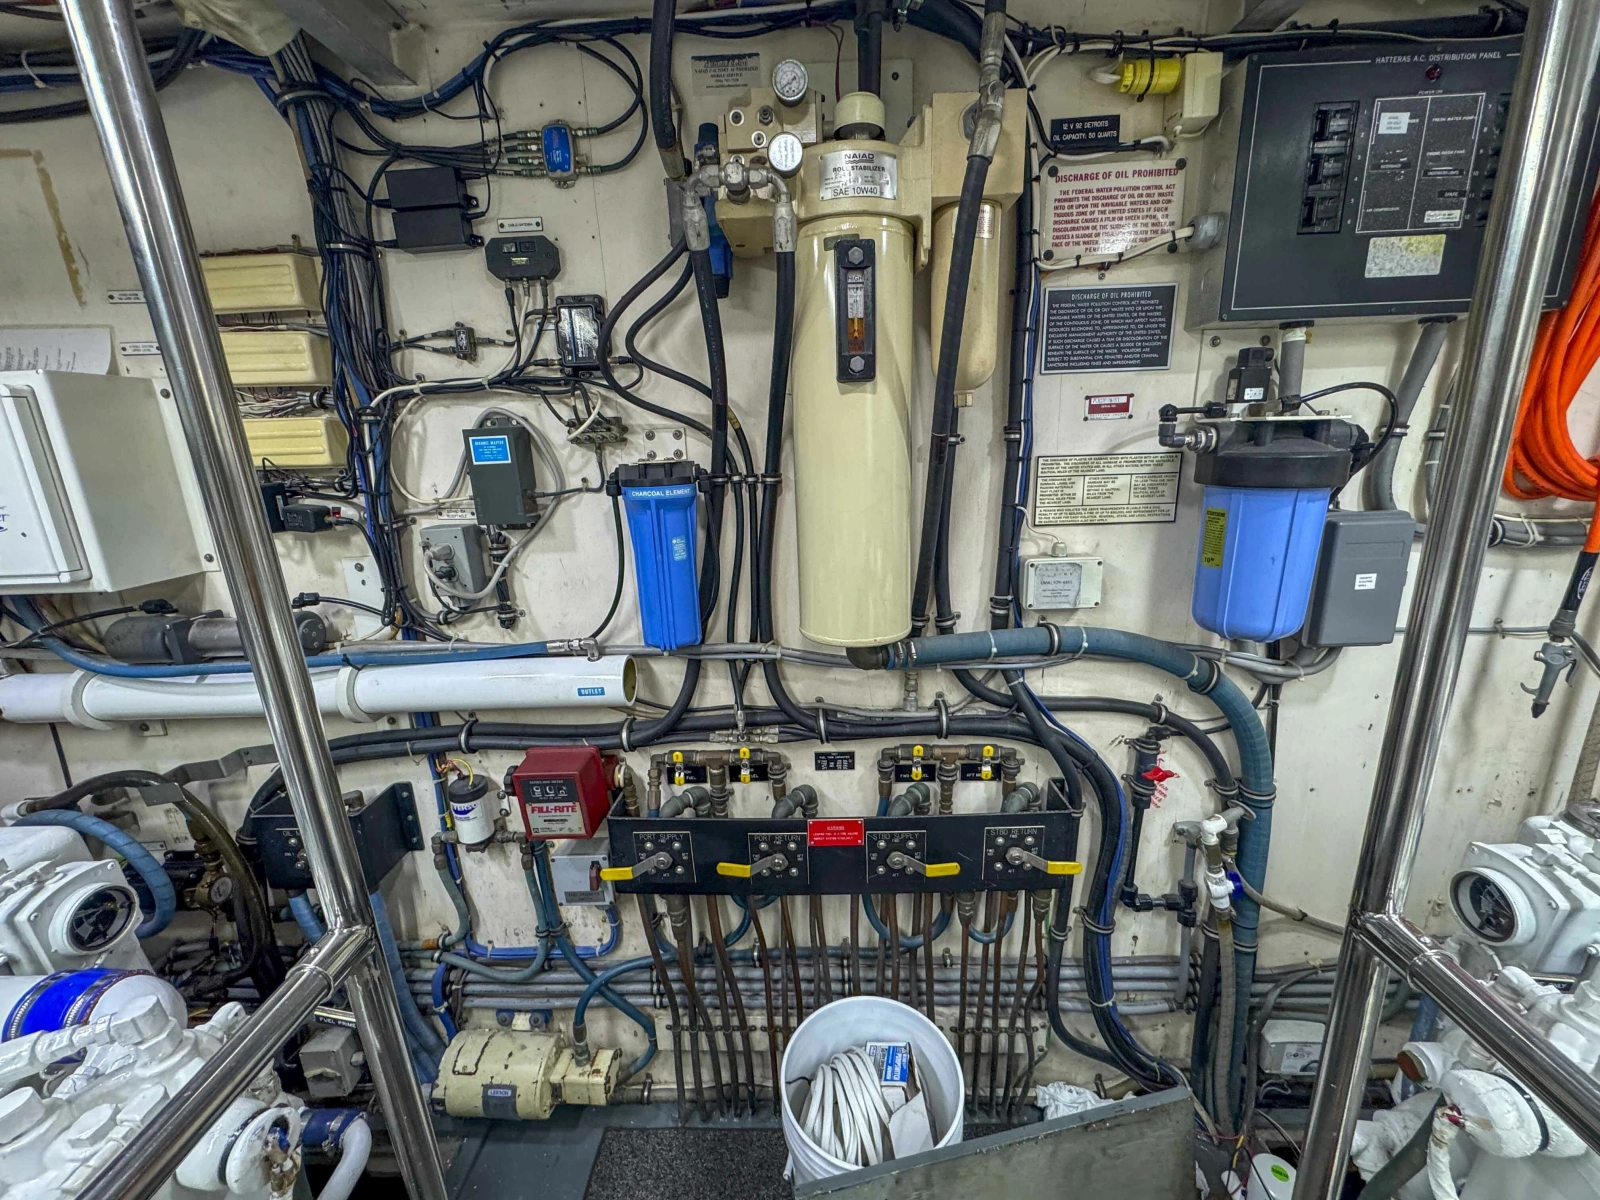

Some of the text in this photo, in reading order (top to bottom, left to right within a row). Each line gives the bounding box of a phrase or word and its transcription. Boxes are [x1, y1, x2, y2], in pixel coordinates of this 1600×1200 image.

[1376, 55, 1411, 63] HATTERAS
[1429, 53, 1477, 62] DISTRIBUTION
[1055, 168, 1179, 183] DISCHARGE OF OIL PROHIBITED
[833, 187, 878, 197] SAE 10W40
[531, 806, 578, 814] FILL-RITE
[320, 1017, 336, 1025] FUEL
